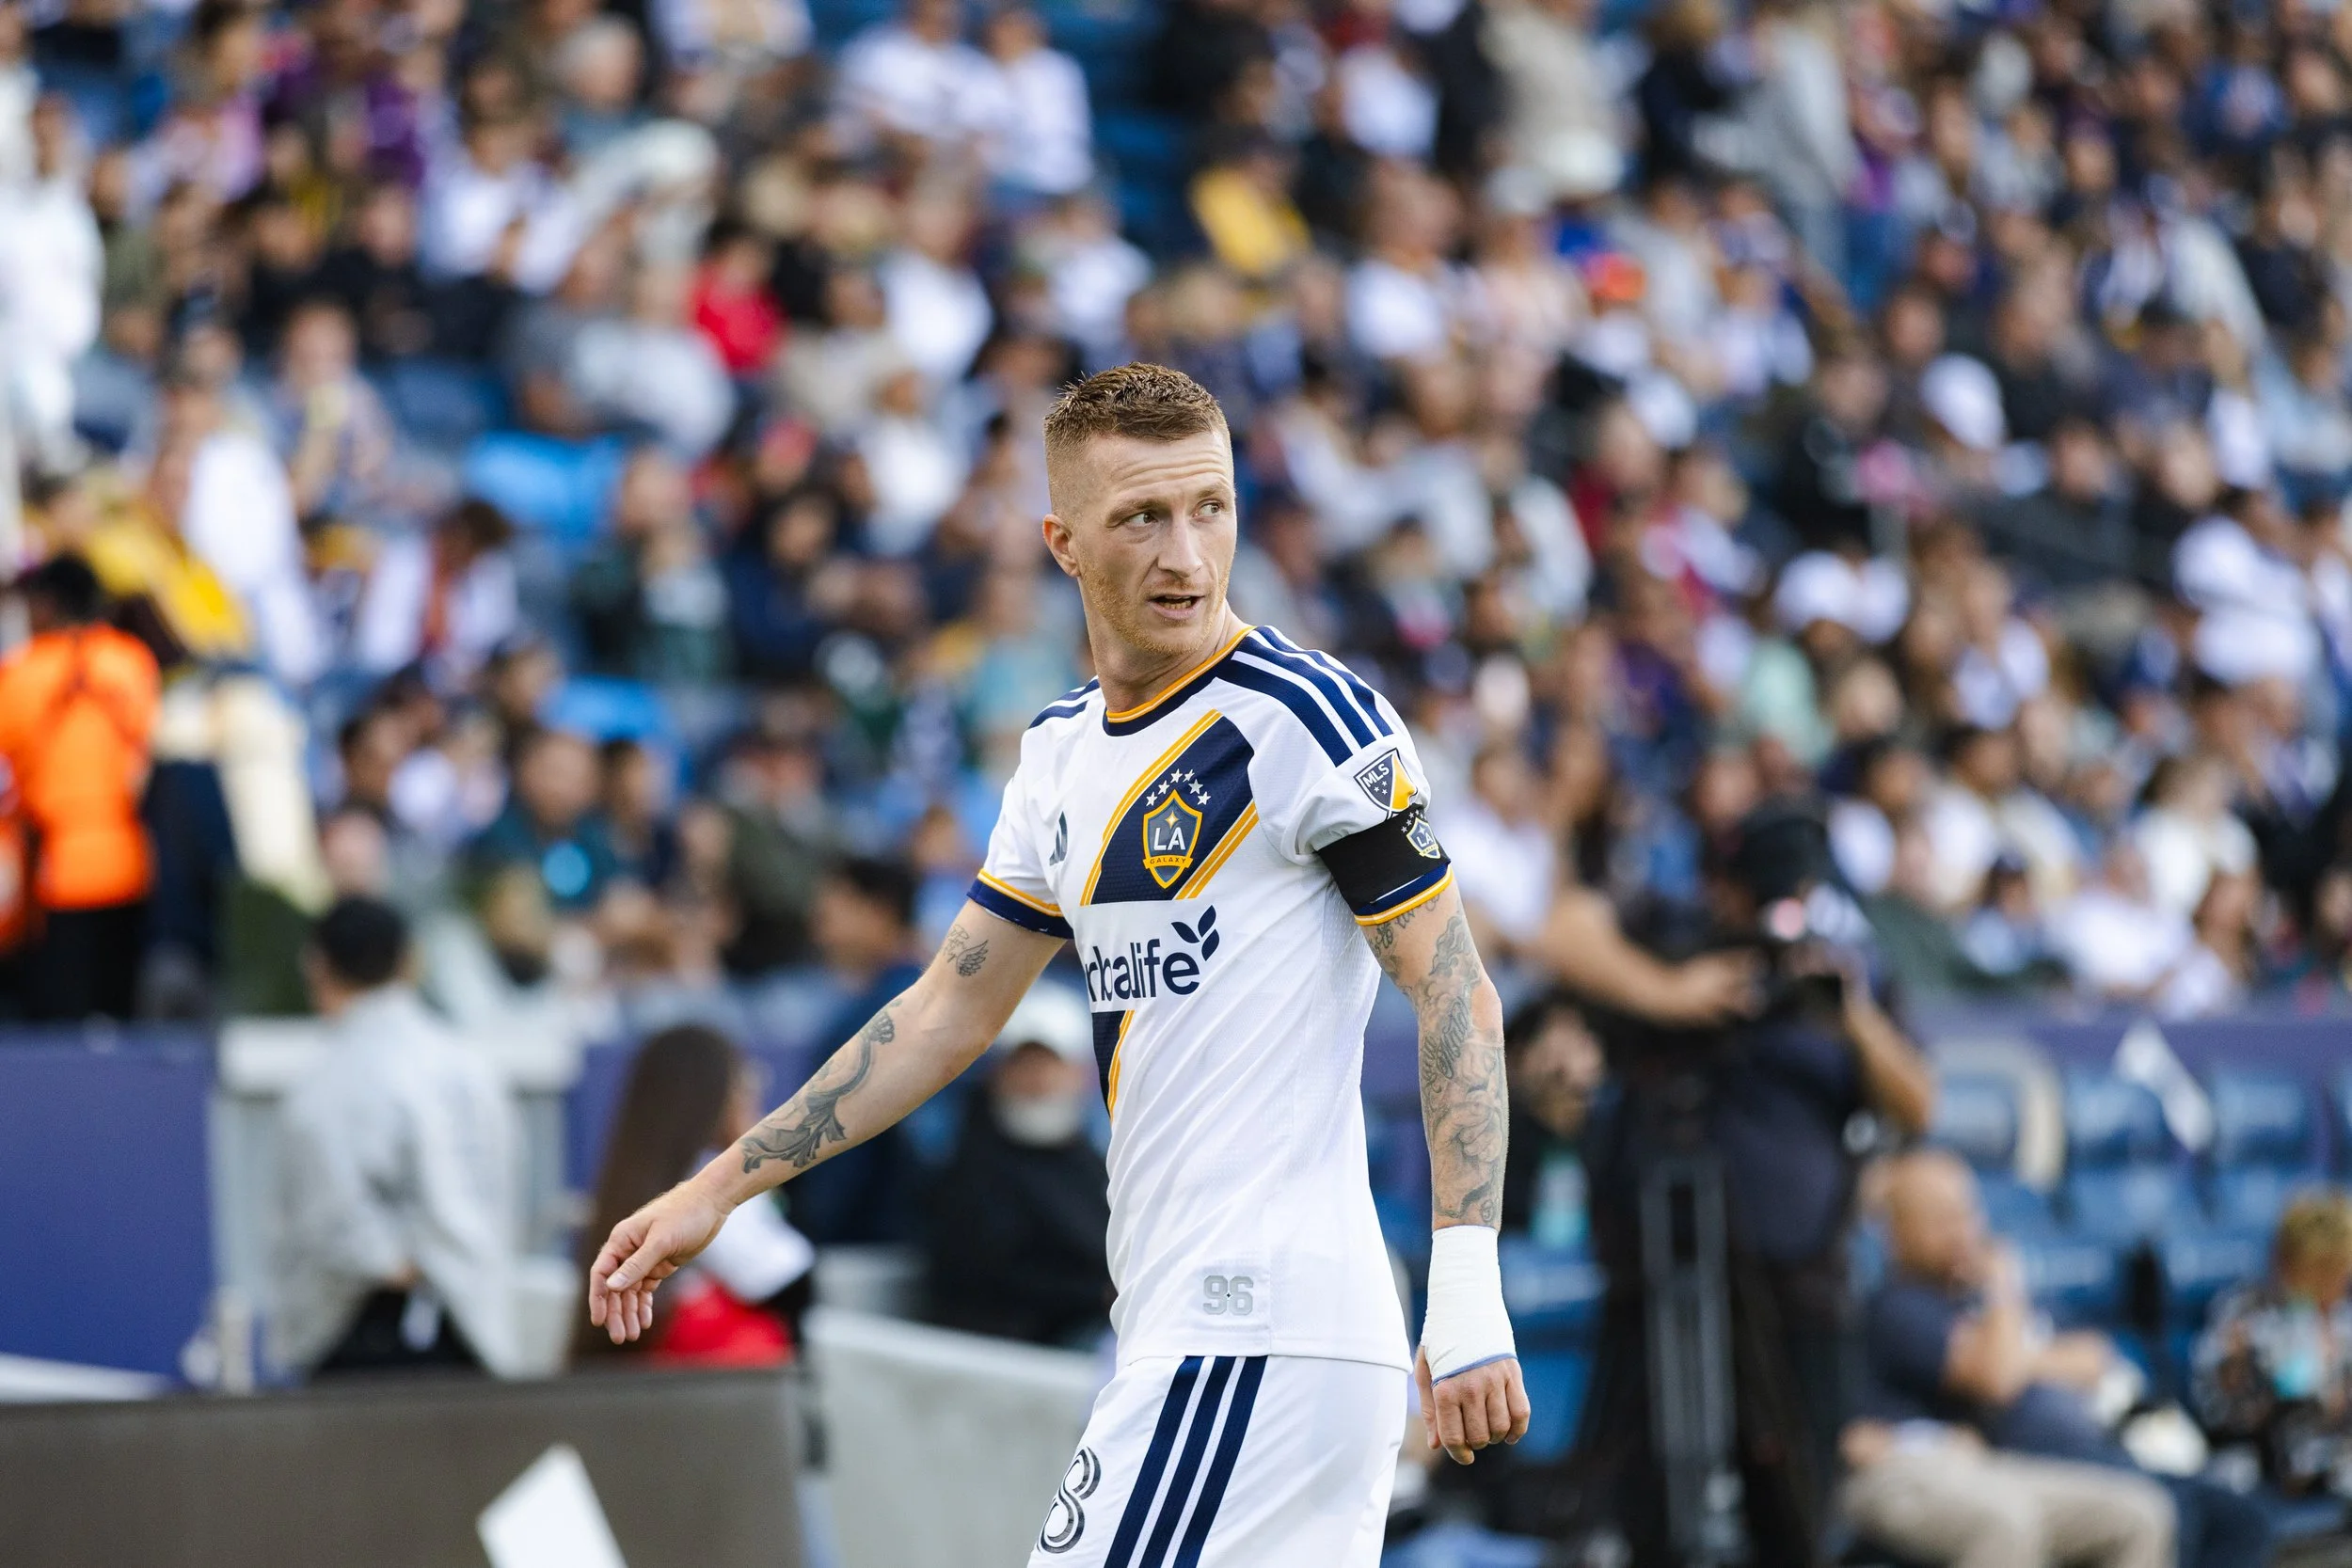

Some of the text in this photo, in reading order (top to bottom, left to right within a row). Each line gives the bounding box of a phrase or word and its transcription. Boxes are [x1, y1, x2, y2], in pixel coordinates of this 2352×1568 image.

[1362, 763, 1390, 788] MLS
[1153, 827, 1186, 851] LA
[1416, 832, 1434, 847] LA
[1085, 939, 1200, 1003] rbalife
[1203, 1275, 1254, 1316] 96
